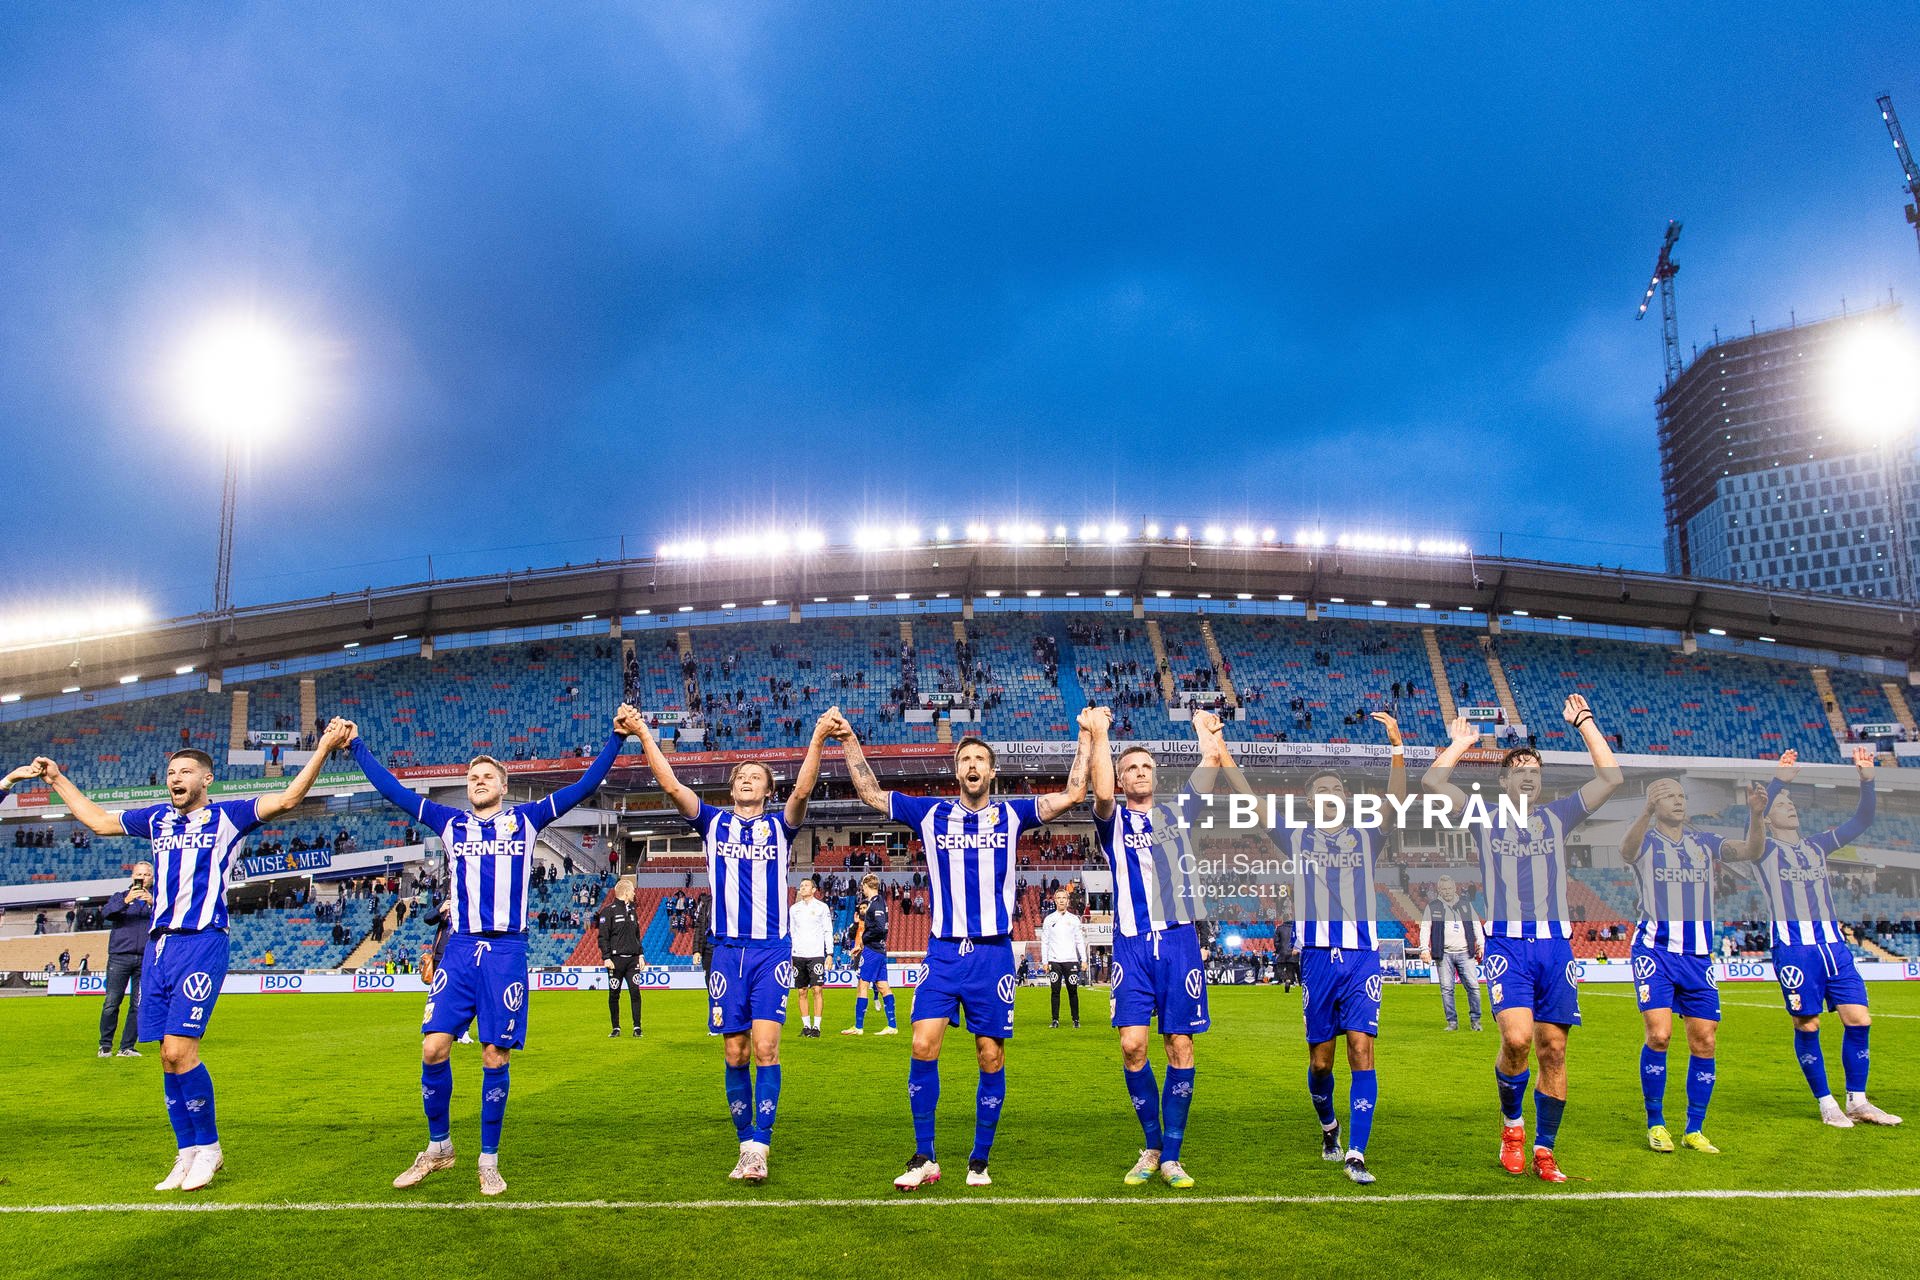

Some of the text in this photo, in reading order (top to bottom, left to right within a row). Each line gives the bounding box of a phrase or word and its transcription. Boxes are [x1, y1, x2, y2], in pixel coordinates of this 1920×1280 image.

[1006, 742, 1044, 754] Ullevi
[1161, 741, 1199, 753] Ullevi
[1240, 743, 1278, 755] Ullevi
[252, 780, 286, 790] shopping
[330, 775, 345, 783] från
[111, 790, 130, 800] dag
[131, 786, 170, 798] imorgon
[153, 833, 215, 854] SERNEKE
[936, 833, 1007, 849] SERNEKE
[1491, 838, 1554, 857] SERNEKE
[453, 840, 524, 857] SERNEKE
[717, 841, 777, 860] SERNEKE
[247, 855, 285, 874] WISE
[299, 850, 330, 868] MEN
[1302, 849, 1364, 868] SERNEKE
[1098, 925, 1112, 934] Ull
[1728, 964, 1764, 977] BDO
[79, 977, 106, 990] BD
[265, 975, 302, 989] BDO
[357, 975, 395, 988] BDO
[542, 973, 579, 986] BDO
[190, 1006, 204, 1020] 23
